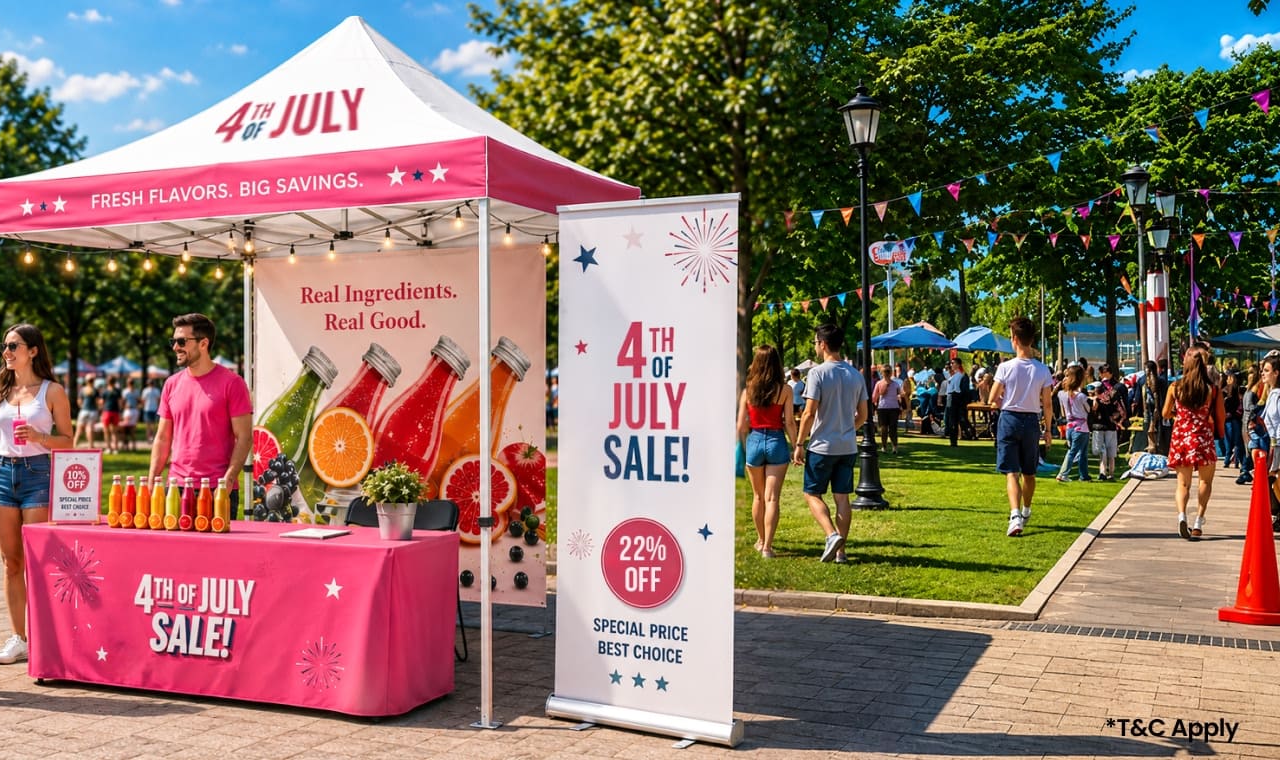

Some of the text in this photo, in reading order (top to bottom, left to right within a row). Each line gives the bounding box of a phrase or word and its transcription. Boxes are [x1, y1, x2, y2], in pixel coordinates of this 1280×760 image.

[242, 121, 266, 141] OF
[268, 87, 365, 139] JULY
[91, 172, 364, 209] FRESH FLAVORS. BIG SAVINGS.
[300, 282, 457, 306] Real Ingredients.
[324, 310, 426, 331] Real Good.
[651, 356, 673, 378] OF
[608, 382, 687, 430] JULY
[603, 434, 689, 483] SALE!
[67, 470, 87, 480] 10%
[67, 481, 86, 489] OFF
[620, 535, 667, 561] 22%
[625, 566, 662, 592] OFF
[177, 583, 197, 605] OF
[198, 577, 256, 616] JULY
[149, 612, 235, 659] SALE!
[593, 617, 689, 642] SPECIAL PRICE
[598, 640, 683, 665] BEST CHOICE
